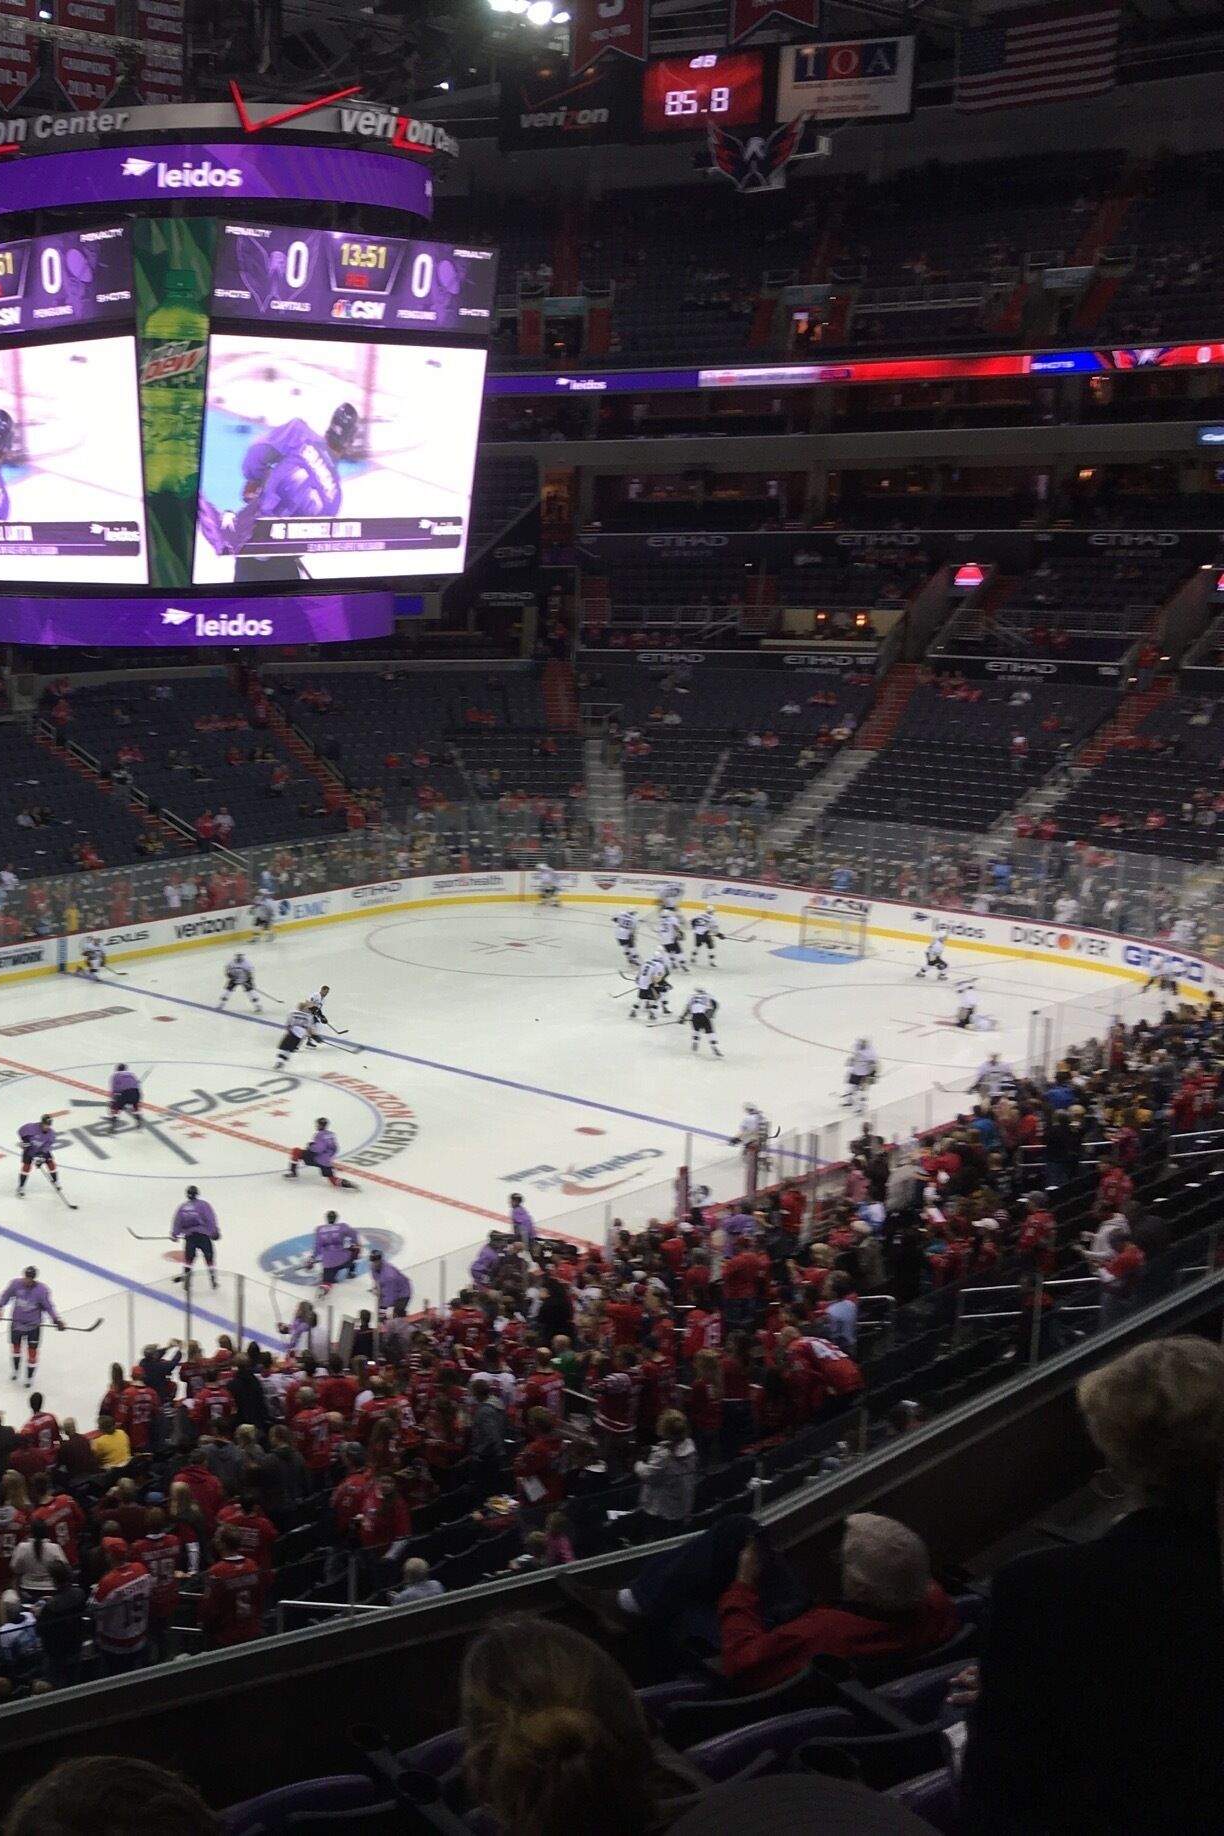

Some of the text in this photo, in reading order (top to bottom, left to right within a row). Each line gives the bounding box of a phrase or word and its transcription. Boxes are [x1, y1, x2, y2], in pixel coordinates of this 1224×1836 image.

[664, 86, 730, 116] 85.8
[33, 110, 129, 139] Center
[339, 106, 438, 153] verizon
[519, 106, 610, 131] verizon
[156, 160, 244, 188] leidos
[285, 240, 309, 288] 0
[340, 242, 387, 269] 13:51
[40, 247, 62, 295] 0
[410, 253, 434, 298] 0
[351, 301, 386, 320] CSN
[563, 378, 608, 391] leidos
[646, 535, 729, 547] ETIHAD
[836, 534, 921, 546] ETIHAD
[1088, 533, 1180, 546] ETIHAD
[195, 611, 273, 637] leidos
[635, 652, 707, 664] ETIHAD
[782, 655, 855, 666] ETIHAD
[984, 661, 1058, 674] ETIHAD
[351, 881, 403, 899] ETIHAD
[293, 901, 327, 919] EMC
[104, 929, 150, 947] LEXUS
[174, 915, 237, 939] verizon
[931, 916, 986, 939] leidos
[1009, 926, 1111, 958] DISCOVER
[1122, 945, 1205, 983] GECO
[322, 1071, 417, 1119] VERIZON
[342, 1121, 420, 1168] CENTER
